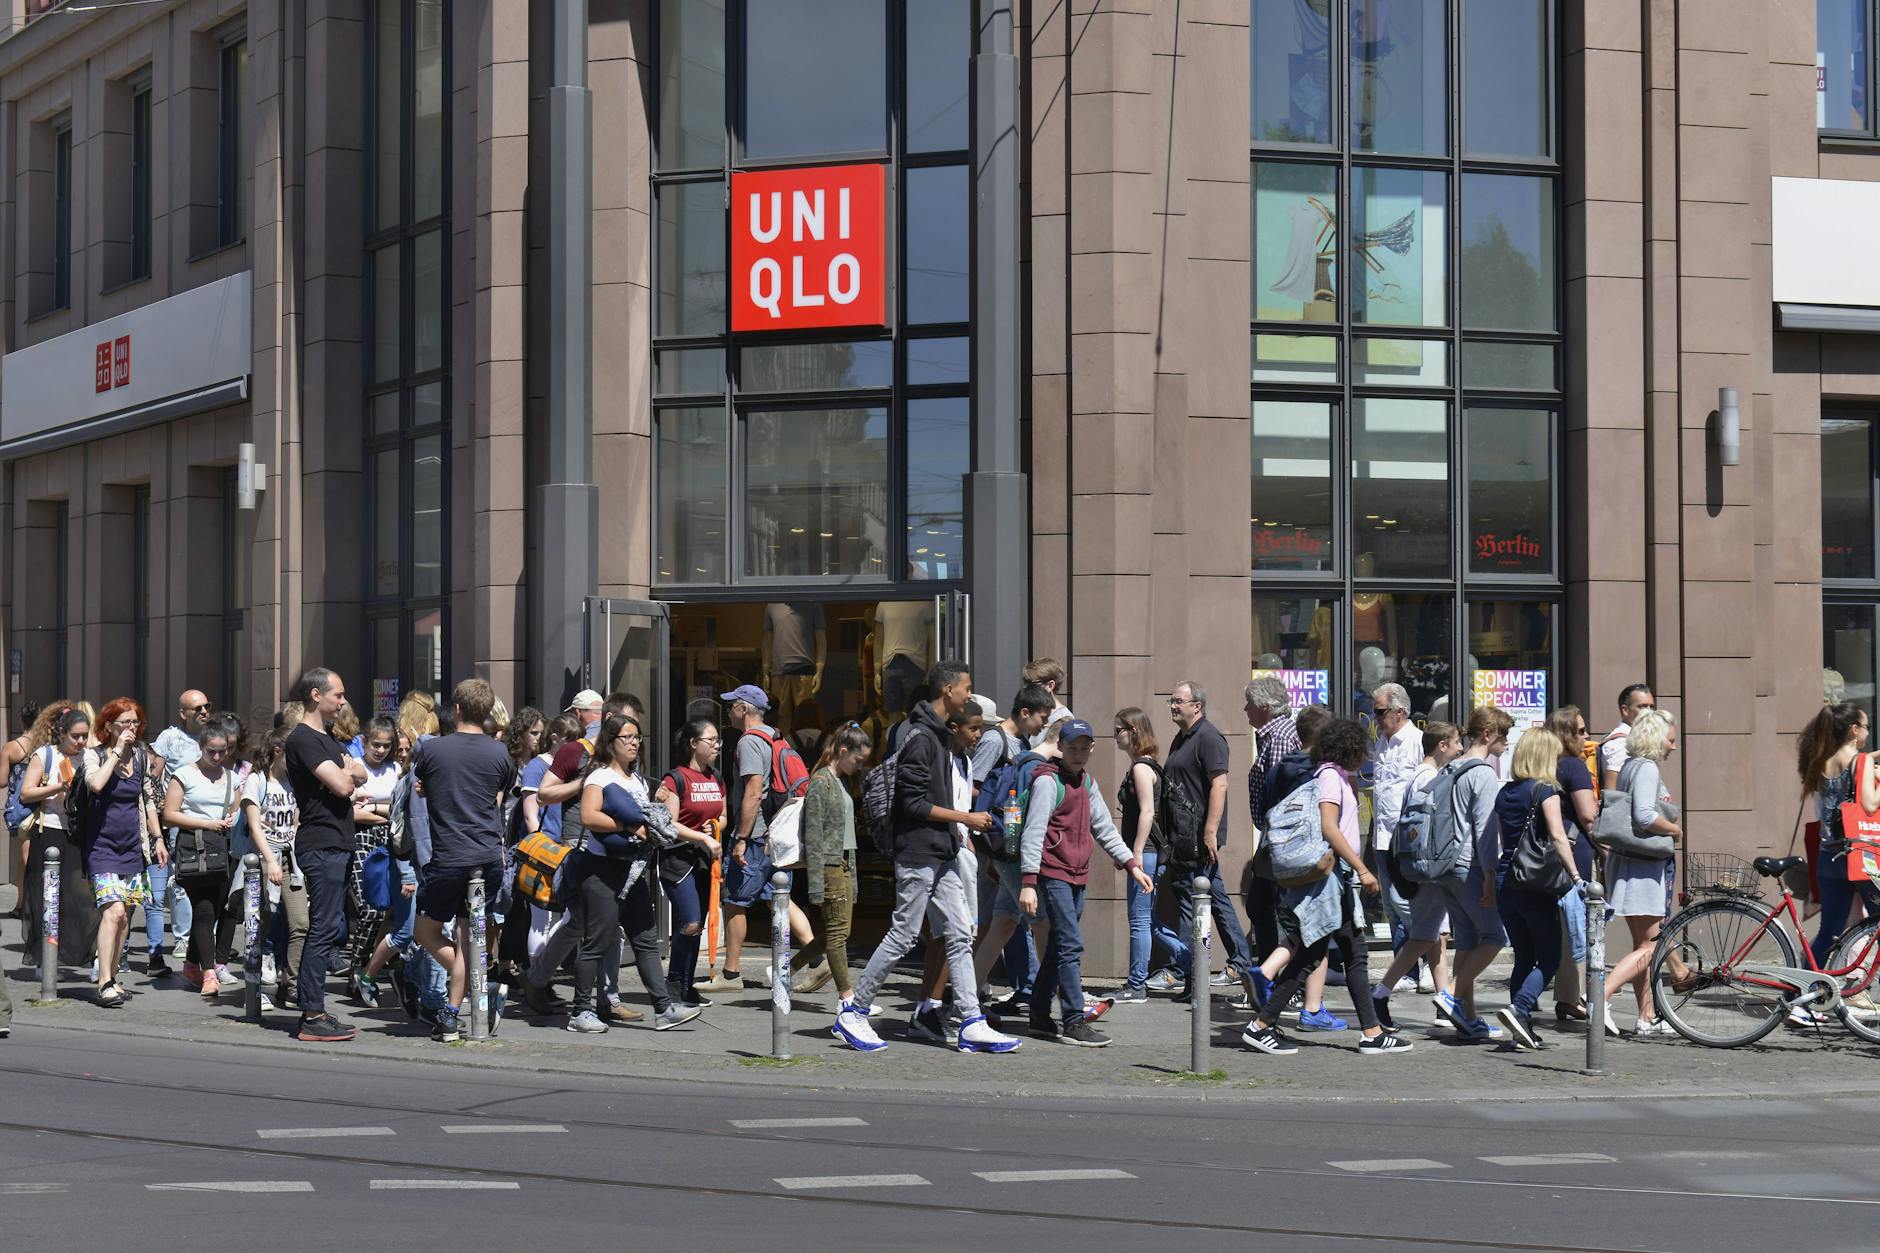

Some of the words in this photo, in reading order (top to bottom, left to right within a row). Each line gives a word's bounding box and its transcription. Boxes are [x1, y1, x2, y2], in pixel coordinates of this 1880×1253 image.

[750, 187, 850, 244] UNI
[750, 253, 861, 318] QLO
[115, 342, 128, 361] UNI
[115, 361, 128, 383] QLO
[1475, 532, 1541, 558] Berlin
[1475, 671, 1545, 689] SOMMER
[1475, 691, 1545, 707] SPECIALS
